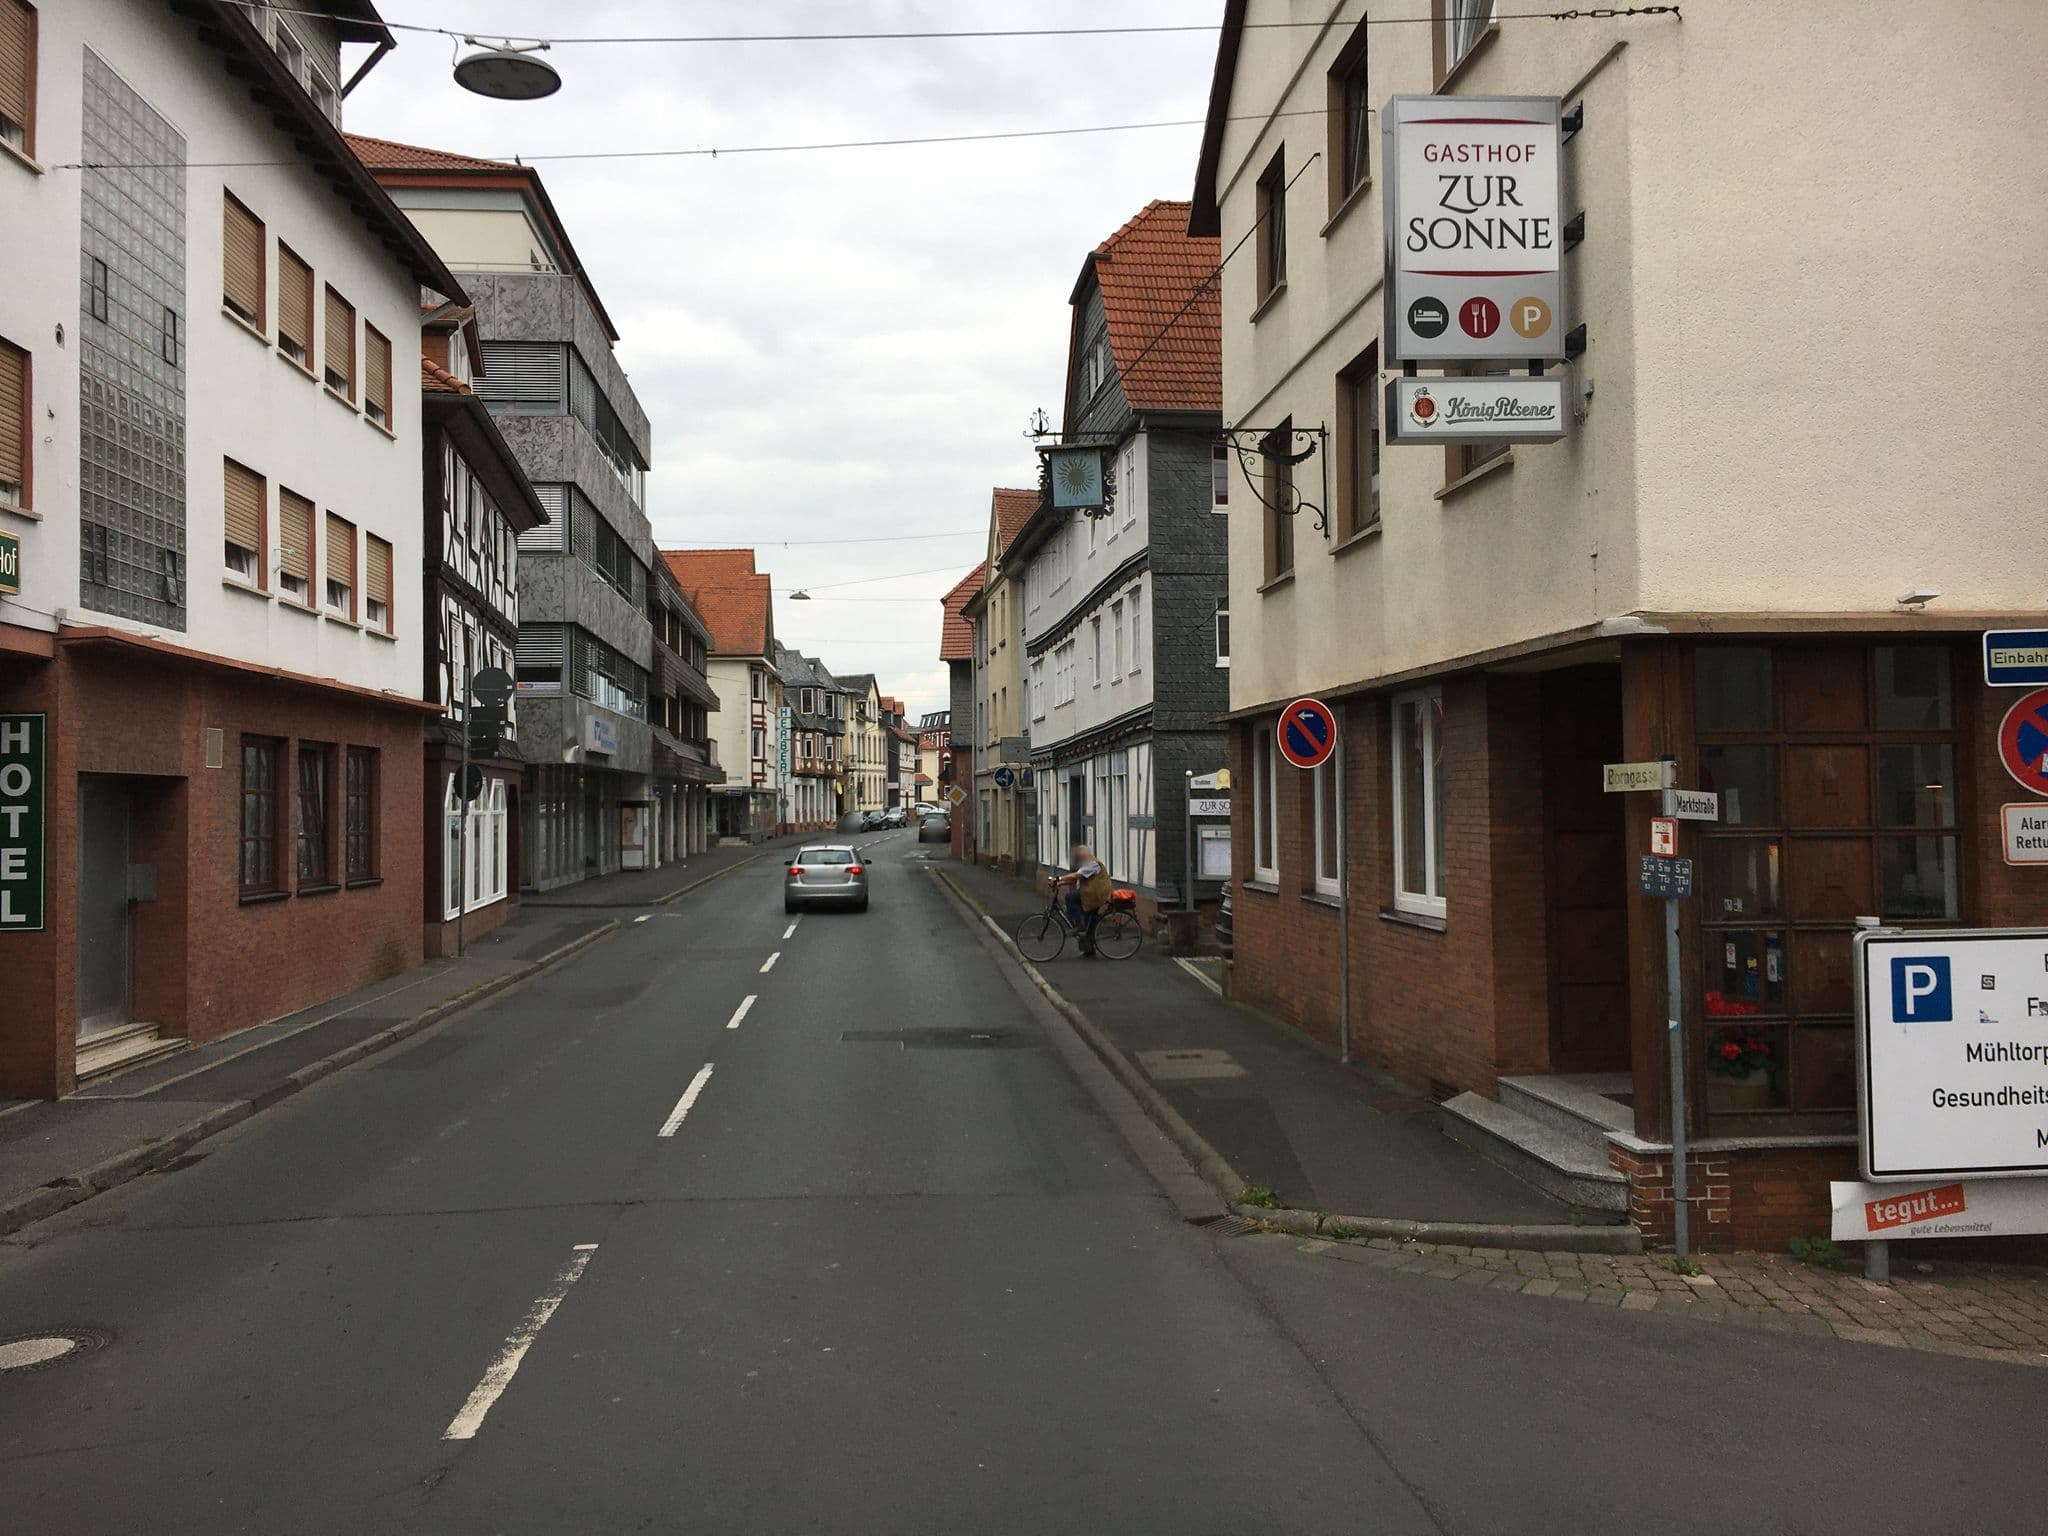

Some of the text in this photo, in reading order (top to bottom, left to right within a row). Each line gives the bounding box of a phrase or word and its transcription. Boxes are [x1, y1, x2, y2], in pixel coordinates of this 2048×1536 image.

[1423, 143, 1537, 163] GASTHOF
[1438, 174, 1524, 214] ZUR
[1406, 216, 1553, 252] SONNE
[1607, 768, 1657, 788] Borngas
[1199, 800, 1217, 812] ZUR
[1676, 795, 1715, 815] Marktstraße
[0, 721, 32, 923] HOTEL
[2021, 816, 2048, 830] Alar
[1904, 964, 1938, 1015] P
[1910, 1221, 1992, 1236] gute Lebensmittel
